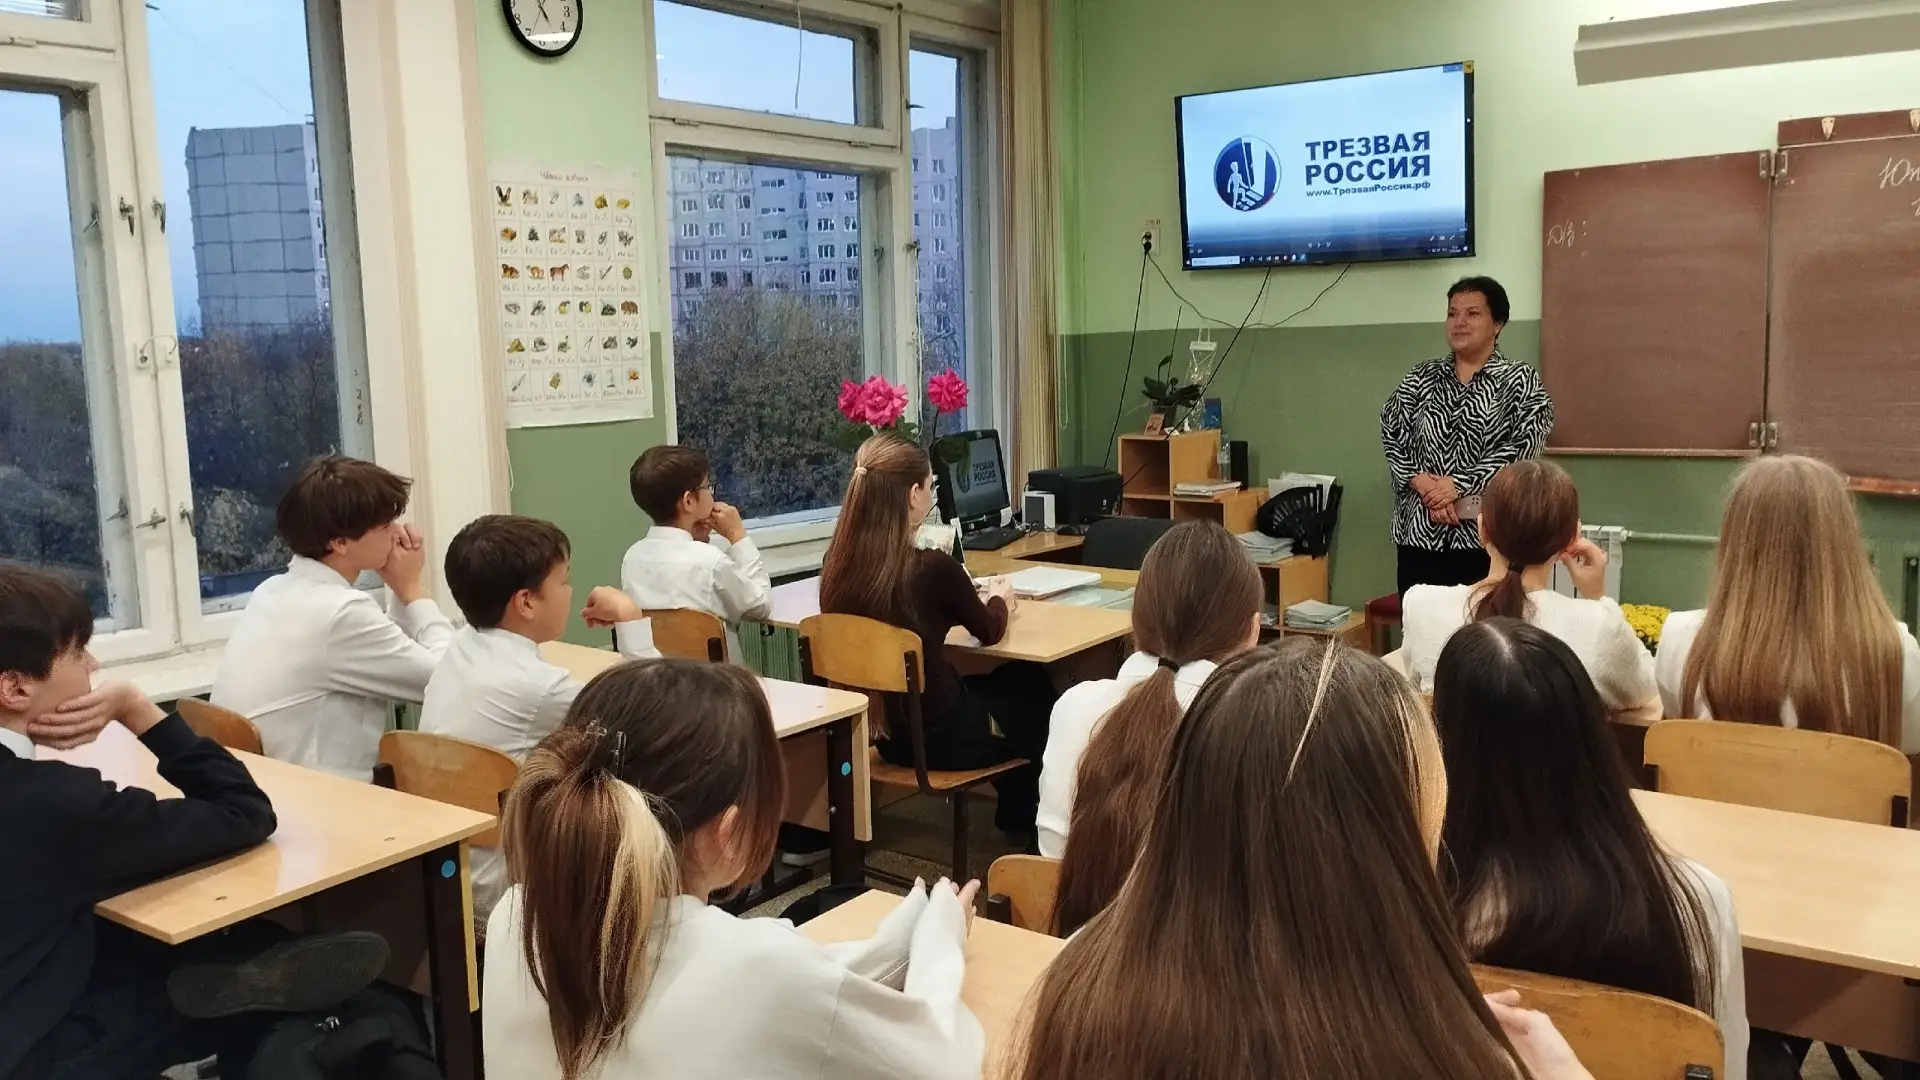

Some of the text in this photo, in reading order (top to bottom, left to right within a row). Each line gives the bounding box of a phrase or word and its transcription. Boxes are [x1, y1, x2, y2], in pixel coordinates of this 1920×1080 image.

[563, 6, 570, 17] 3
[1305, 130, 1430, 161] ТРЕЗВАЯ
[1305, 154, 1430, 186] РОССИЯ
[1306, 180, 1431, 197] www.ТрезваяРоссия.рф
